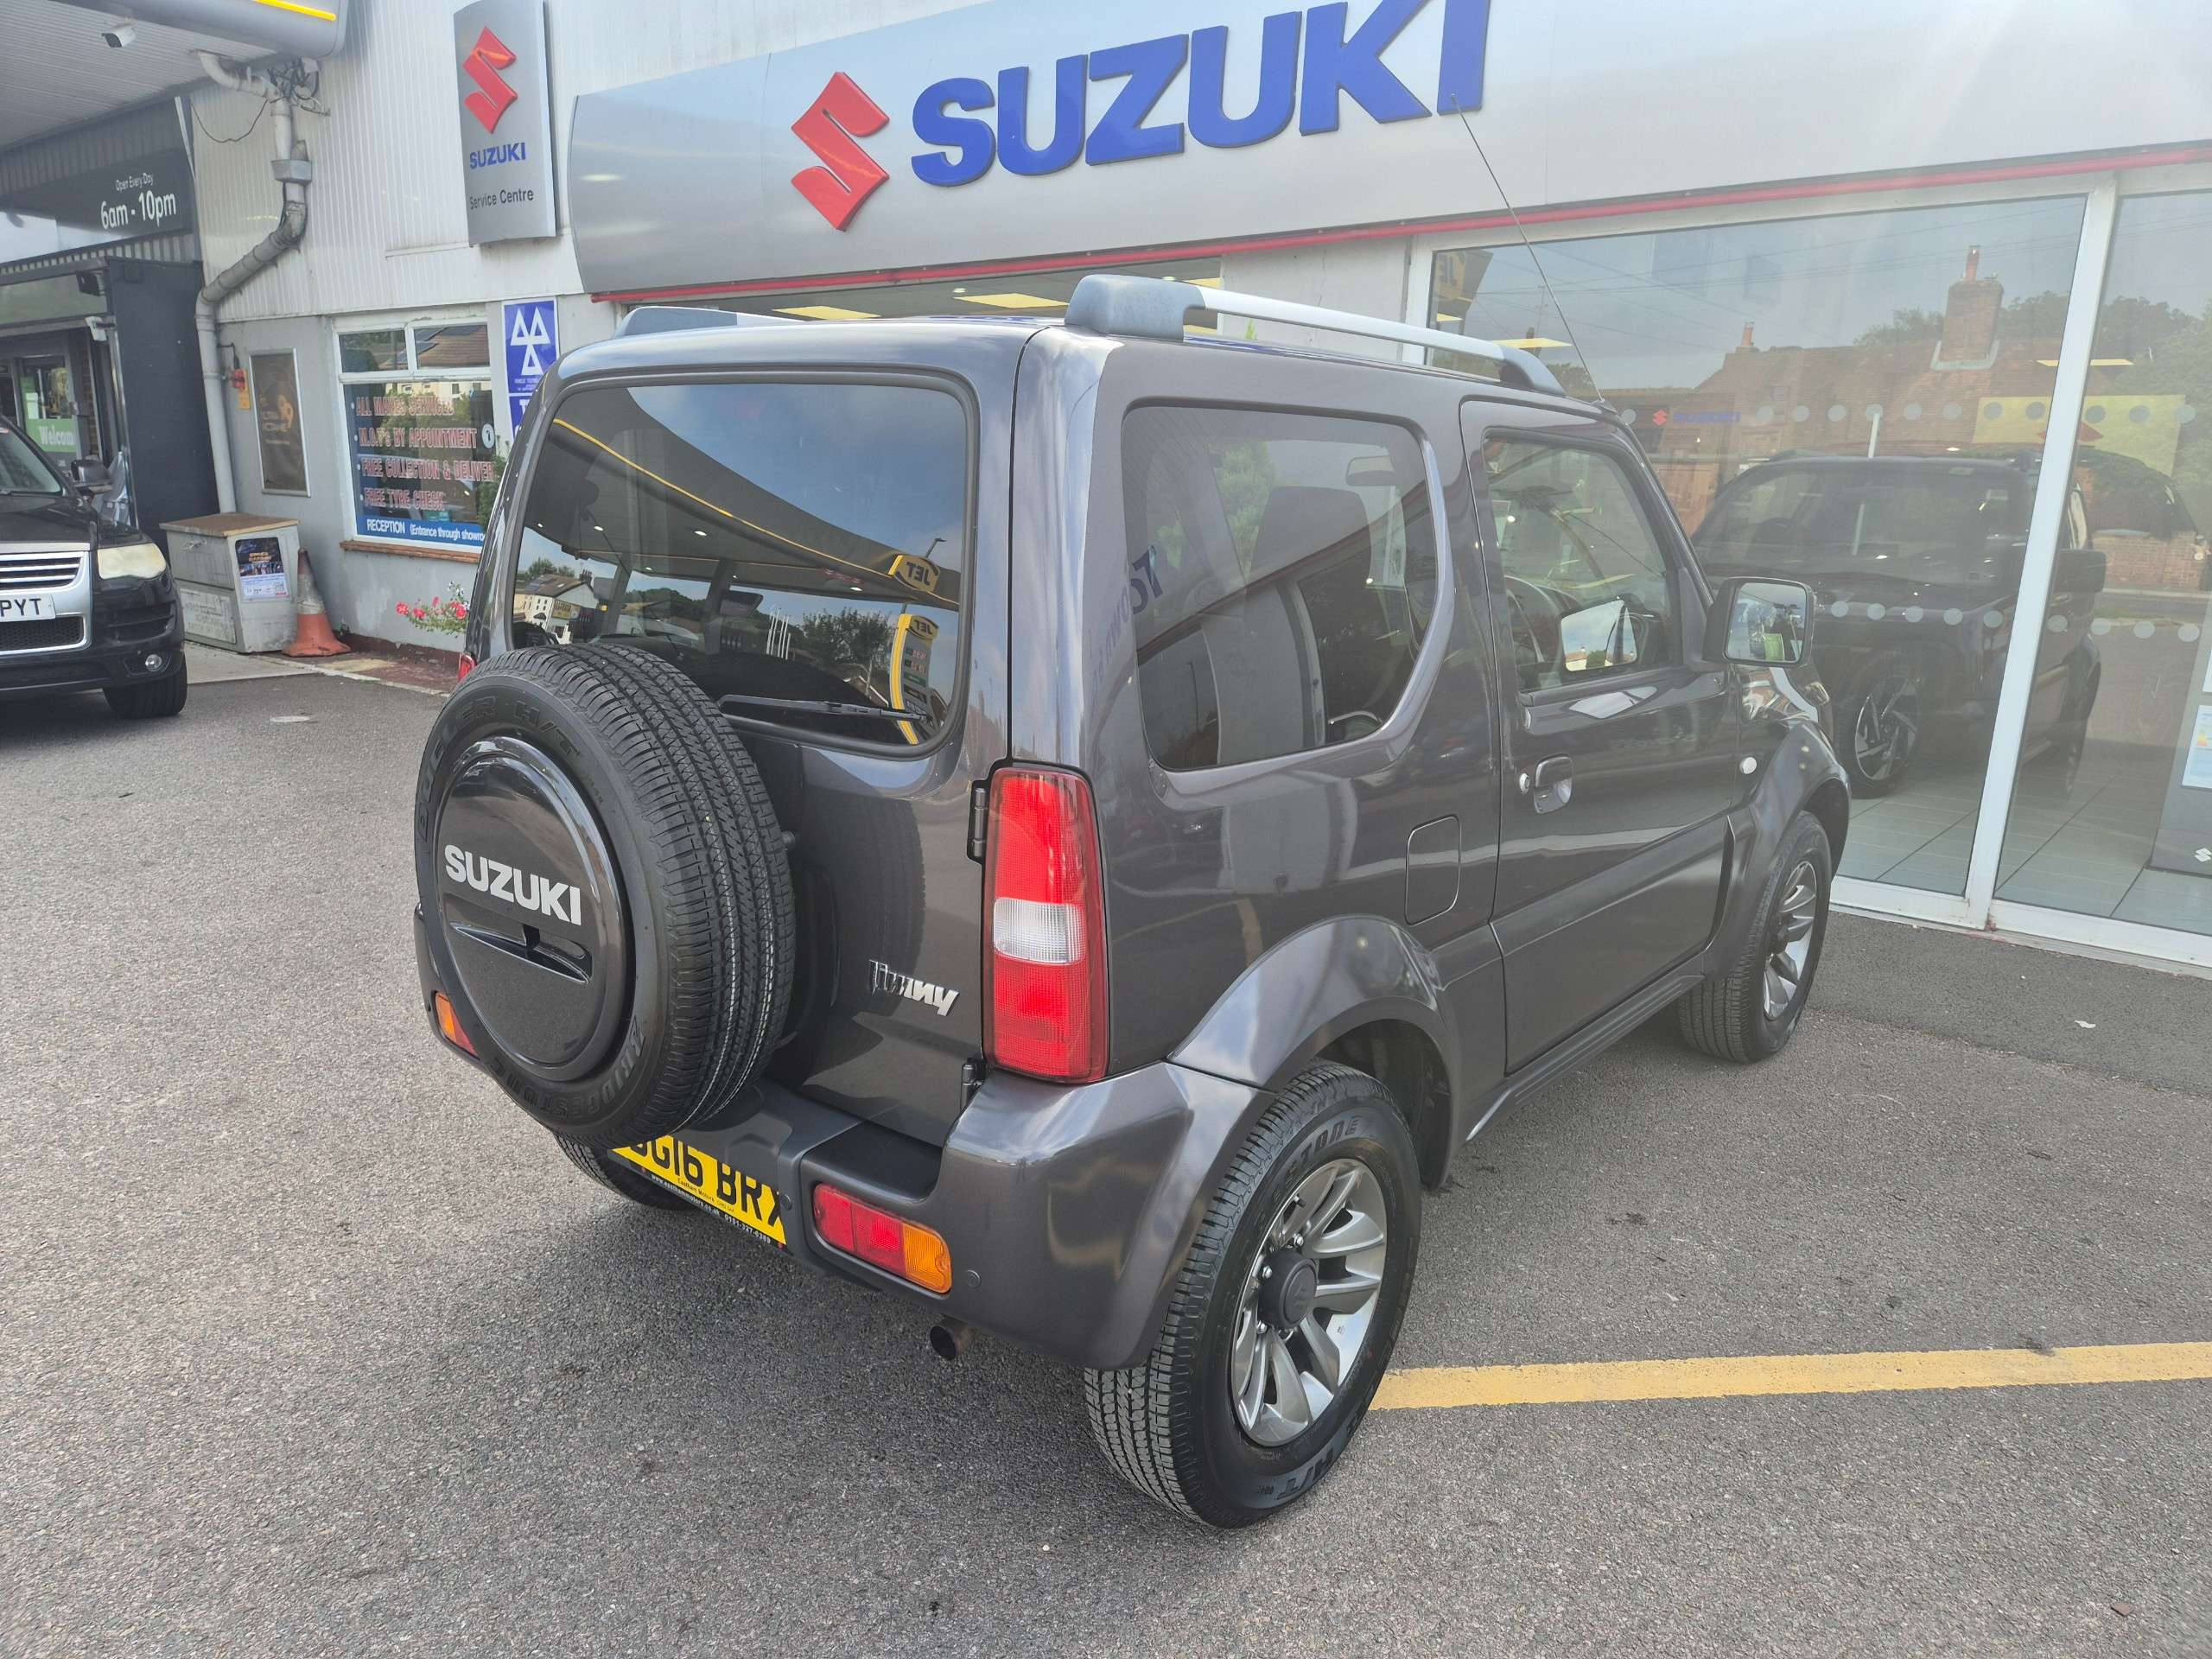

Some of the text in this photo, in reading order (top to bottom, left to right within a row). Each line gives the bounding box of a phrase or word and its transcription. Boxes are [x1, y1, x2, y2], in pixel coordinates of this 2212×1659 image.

[911, 0, 1492, 188] SUZUKI
[469, 142, 526, 169] SUZUKI
[115, 172, 154, 193] Open Every Day
[101, 200, 129, 230] 6am
[138, 190, 176, 227] 10pm
[469, 188, 534, 210] Service Centre
[356, 397, 372, 416] ALL
[373, 396, 405, 416] MAKES
[393, 428, 405, 448] BY
[409, 428, 477, 448] APPOINTMENT
[361, 457, 495, 482] FREE COLLECTION & DELIVER
[364, 487, 446, 512] FREE TYRE CHECK
[367, 518, 486, 542] RECEPTION (Entrance through showro
[0, 598, 41, 617] PYT
[444, 844, 582, 926] SUZUKI
